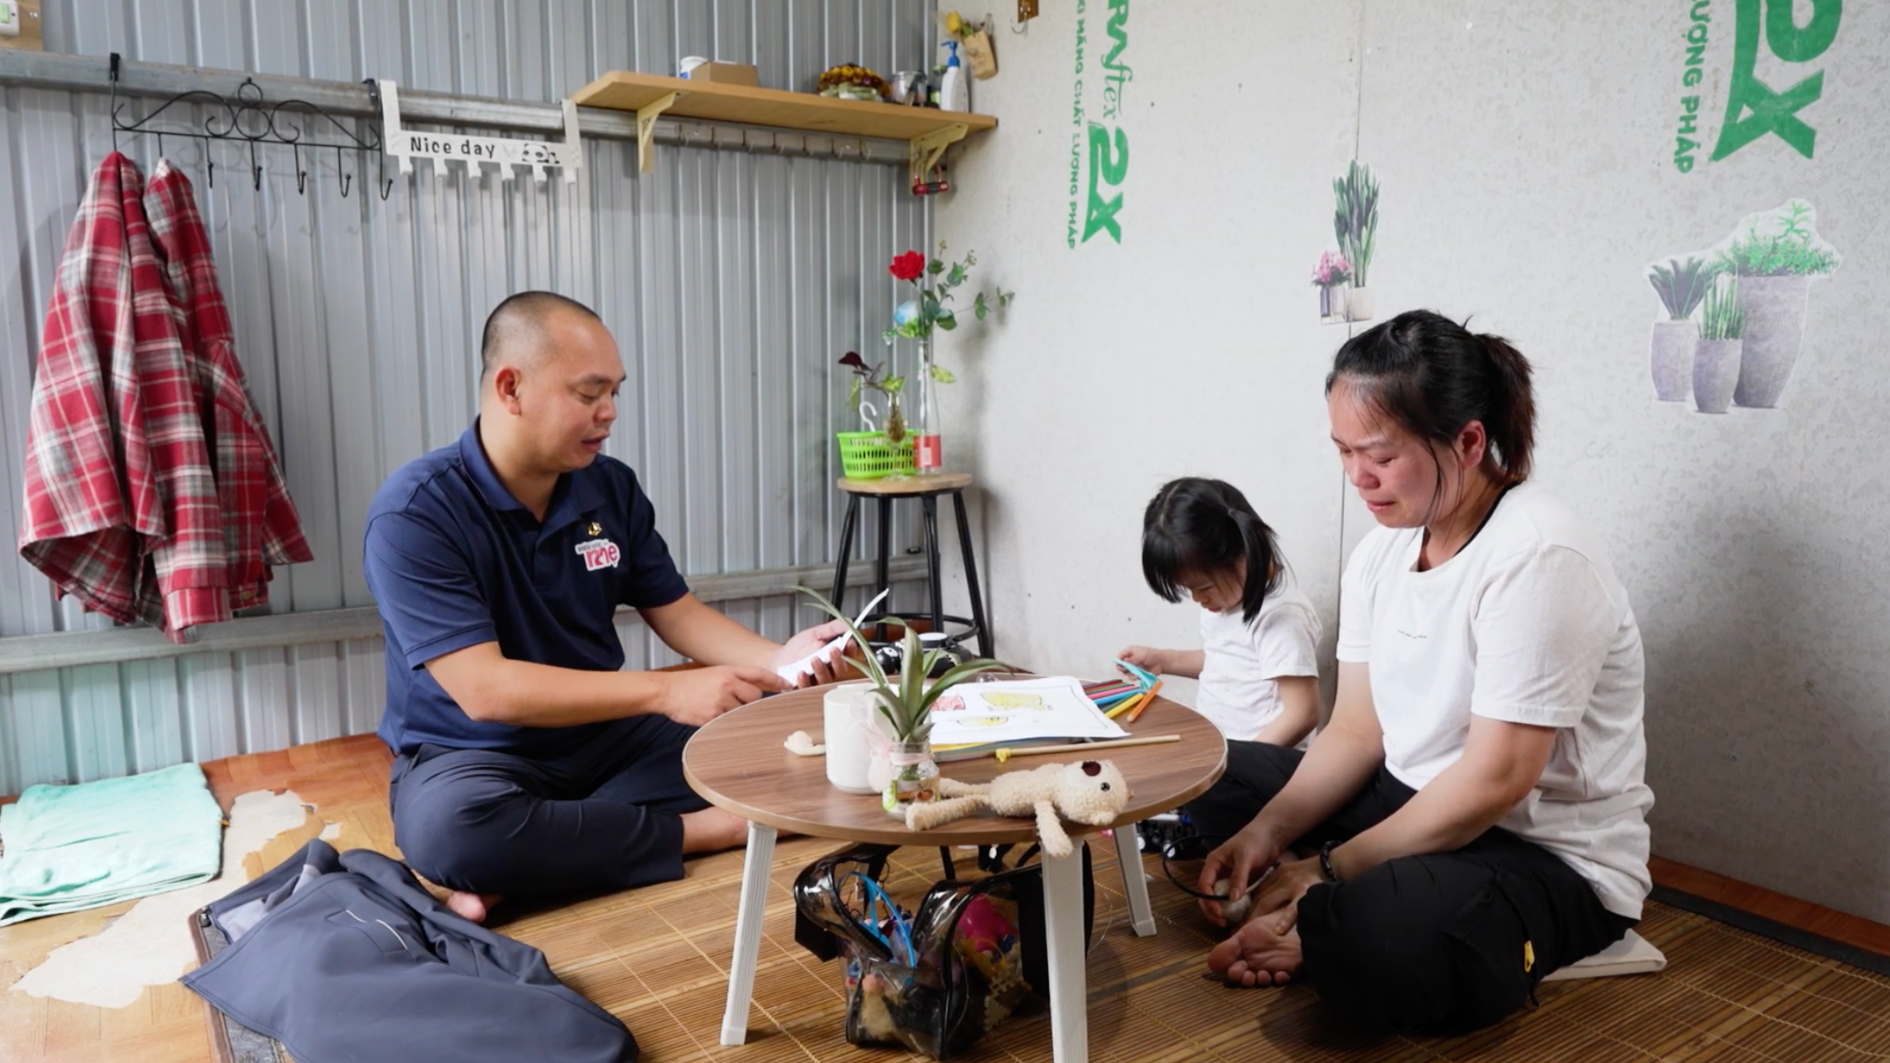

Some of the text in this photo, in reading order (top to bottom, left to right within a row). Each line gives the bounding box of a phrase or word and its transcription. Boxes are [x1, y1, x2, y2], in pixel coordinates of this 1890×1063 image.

[1075, 18, 1087, 74] MĂNG
[1073, 79, 1085, 127] CHẤT
[1673, 0, 1712, 174] ƯỢNG PHÁP
[410, 136, 496, 159] Nice day
[1069, 133, 1081, 196] LƯỢNG
[1080, 120, 1129, 245] 2X
[1067, 201, 1079, 250] PHÁP
